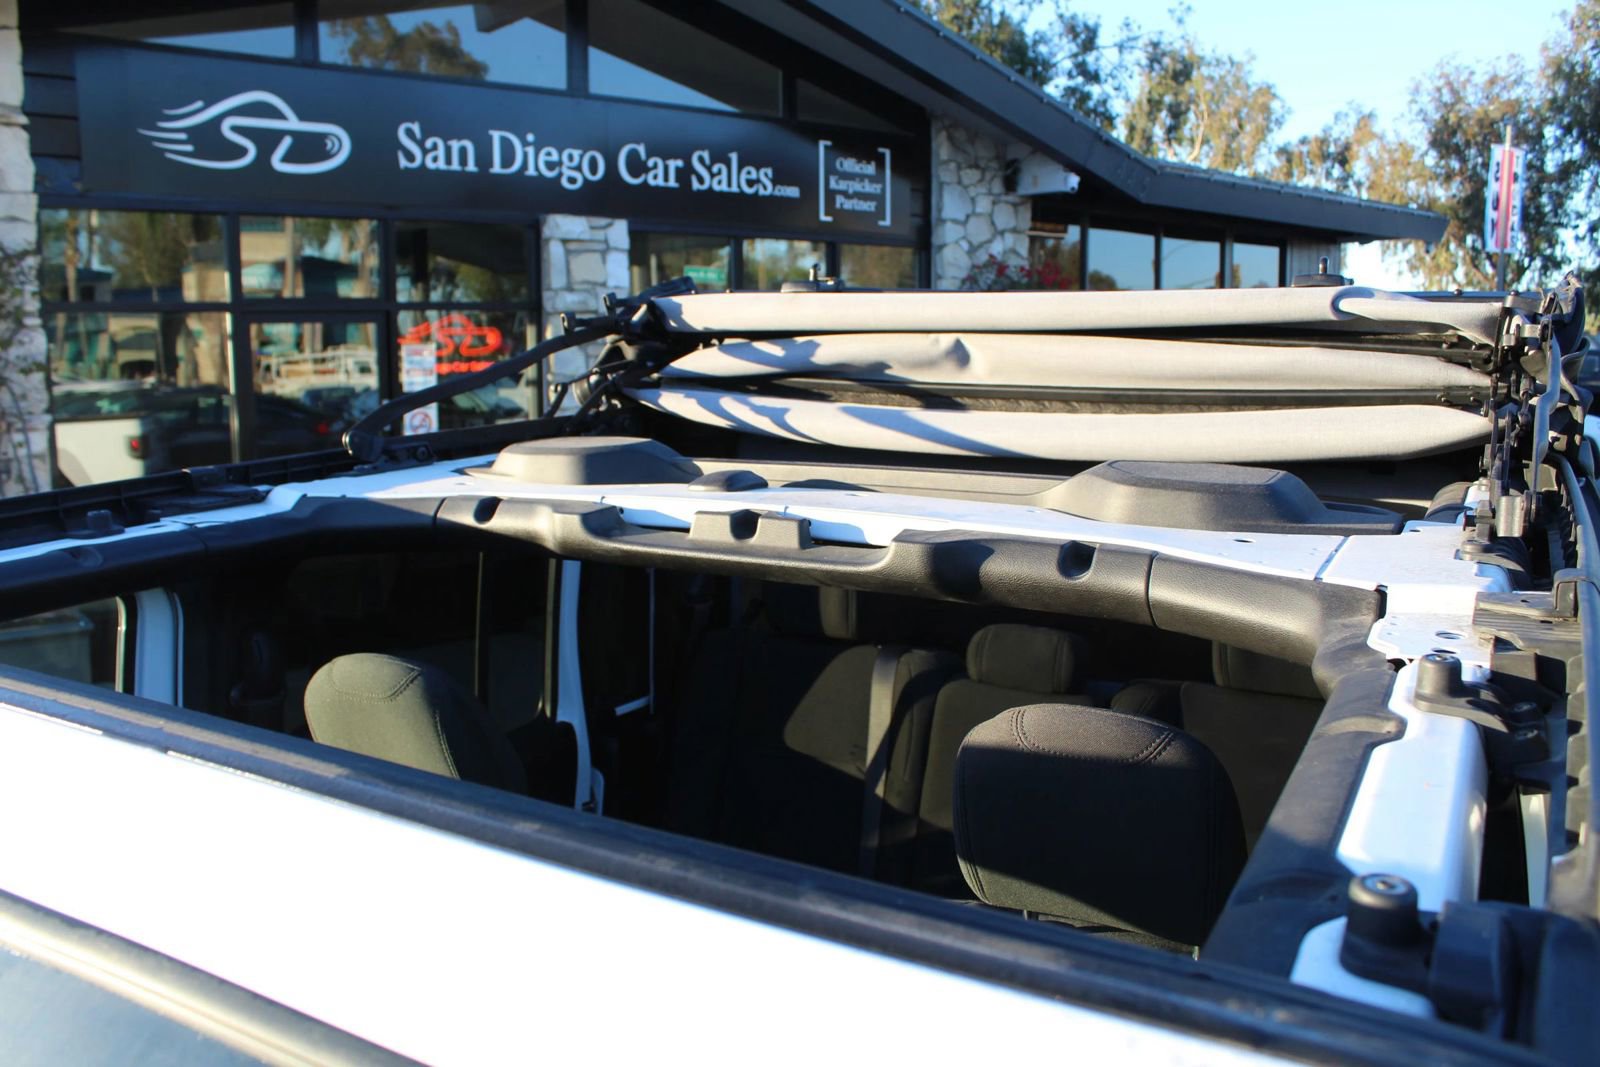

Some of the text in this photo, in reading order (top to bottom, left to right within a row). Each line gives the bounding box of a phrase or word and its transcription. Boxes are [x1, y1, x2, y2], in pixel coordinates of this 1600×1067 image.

[396, 120, 479, 173] San
[488, 129, 606, 191] Diego
[617, 142, 683, 189] Car
[835, 157, 876, 176] Official
[835, 195, 877, 212] Partner
